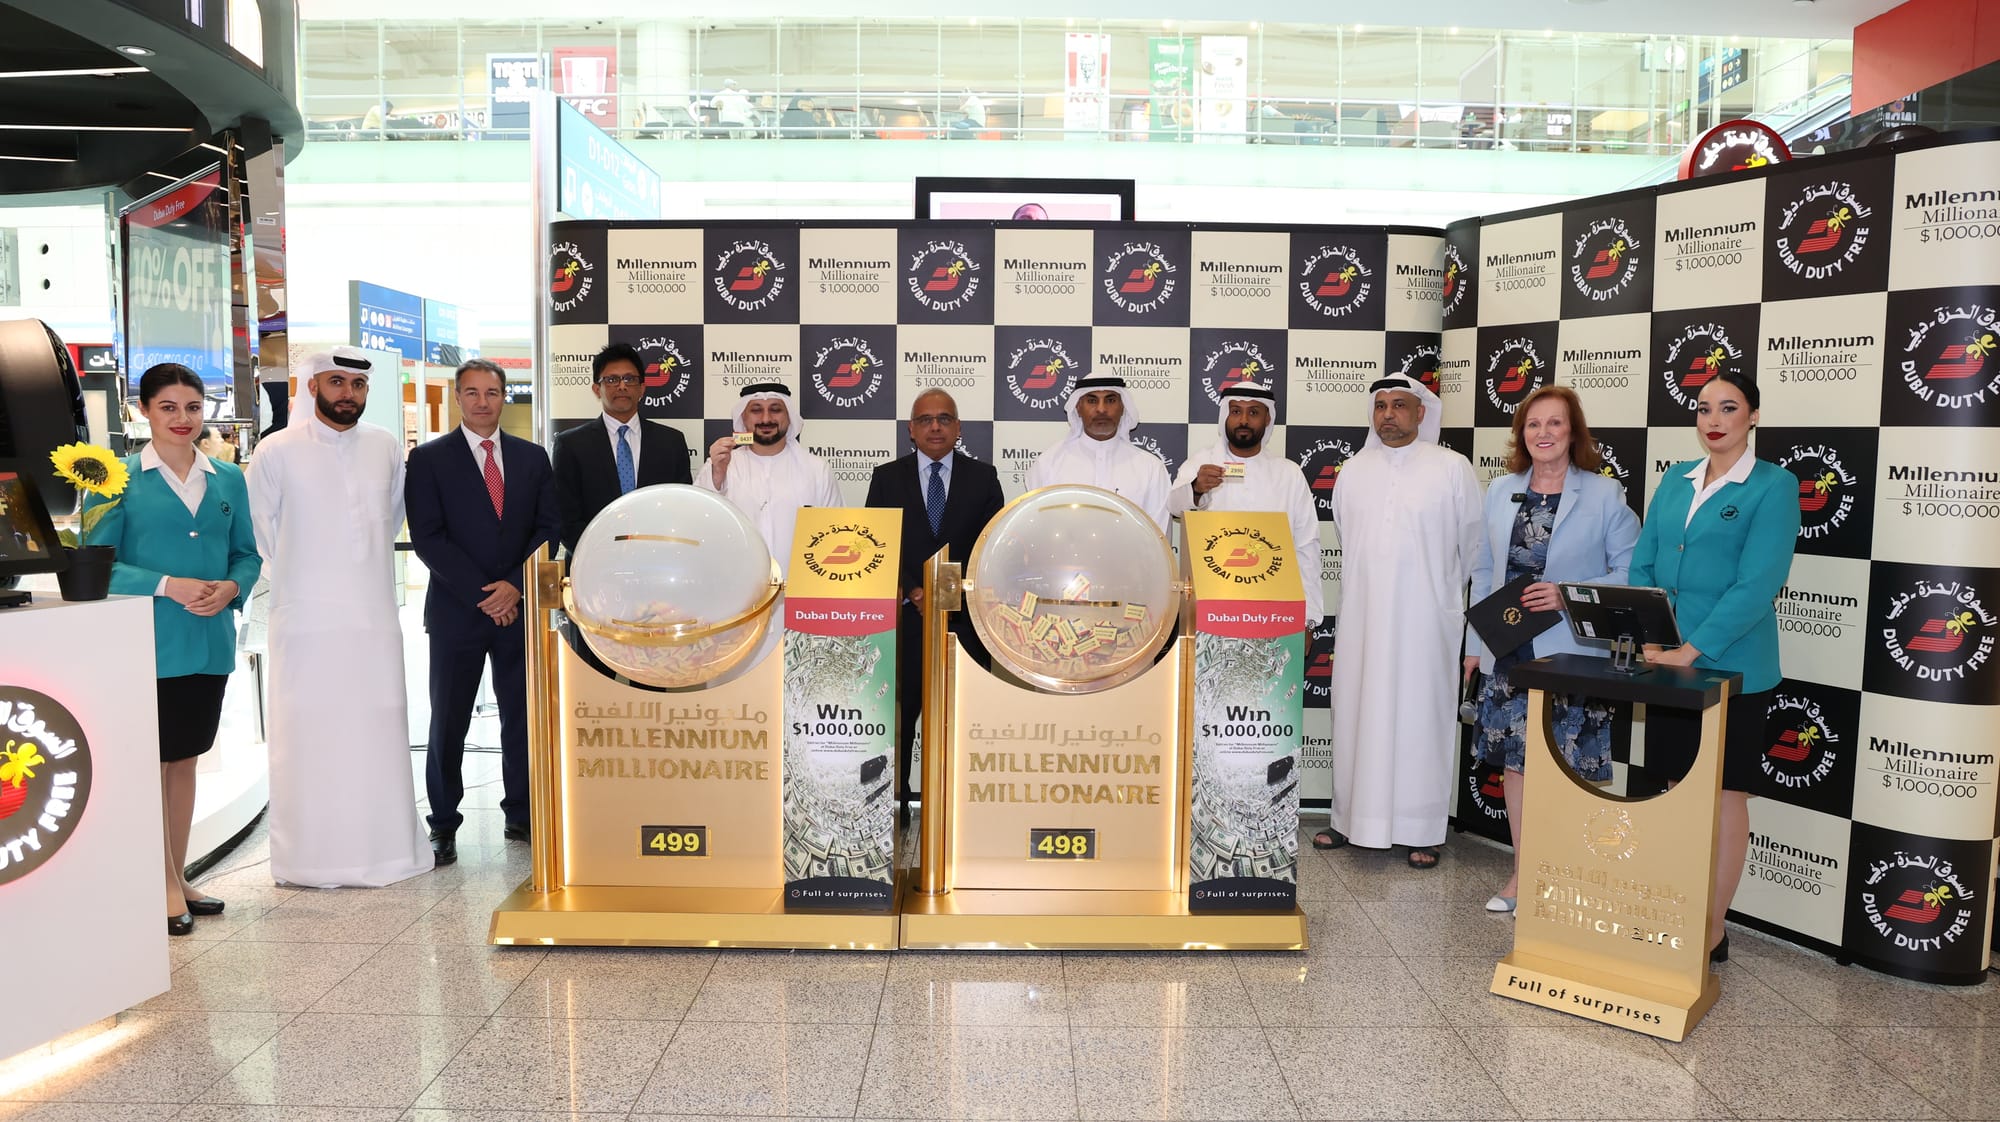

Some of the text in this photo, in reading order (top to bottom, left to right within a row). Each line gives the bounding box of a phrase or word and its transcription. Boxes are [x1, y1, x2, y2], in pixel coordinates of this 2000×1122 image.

[153, 199, 186, 221] Dubai Duty Free
[1664, 221, 1756, 243] Millennium
[1677, 237, 1742, 255] Millionaire
[1776, 227, 1869, 279] DUBAI DUTY FREE
[616, 259, 697, 269] Millennium
[808, 258, 890, 269] Millennium
[1003, 259, 1086, 270] Millennium
[1200, 261, 1283, 273] Millennium
[1486, 250, 1556, 268] Millennium
[173, 246, 216, 313] OFF
[628, 271, 686, 281] Millionaire
[820, 270, 879, 281] Millionaire
[1016, 271, 1075, 282] Millionaire
[1212, 274, 1271, 285] Millionaire
[1496, 264, 1546, 279] Millionaire
[1571, 257, 1639, 301] DUBAI DUTY FREE
[714, 276, 785, 311] DUBAI DUTY FREE
[908, 277, 979, 311] DUBAI DUTY FREE
[1104, 278, 1175, 314] DUBAI DUTY FREE
[1767, 335, 1874, 352] Millennium
[1781, 351, 1857, 366] Millionaire
[812, 373, 883, 408] DUBAI DUTY FREE
[1888, 465, 2000, 483] Millenniu
[1905, 483, 2000, 500] Millionaire
[804, 552, 885, 582] DUBAI DUTY FREE
[1203, 555, 1283, 584] DUBAI DUTY FREE
[795, 610, 885, 623] Dubai Duty Free
[1207, 613, 1295, 624] Dubai Duty Free
[1883, 628, 1995, 682] DUBAI DUTY FREE
[816, 703, 862, 720] Win
[1226, 705, 1271, 721] Win
[576, 727, 768, 750] MILLENNIUM
[792, 722, 886, 737] $1,000,000
[1202, 724, 1294, 738] $1,000,000
[1869, 736, 1994, 765] Millennium
[577, 757, 769, 780] MILLIONAIRE
[968, 752, 1161, 775] MILLENNIUM
[1884, 757, 1978, 781] Millionaire
[968, 783, 1160, 805] MILLIONAIRE
[650, 832, 700, 852] 499
[1037, 835, 1088, 855] 498
[803, 889, 821, 897] Full
[1862, 892, 1971, 951] DUBAI DUTY FREE
[1508, 975, 1661, 1025] Full of surprises
